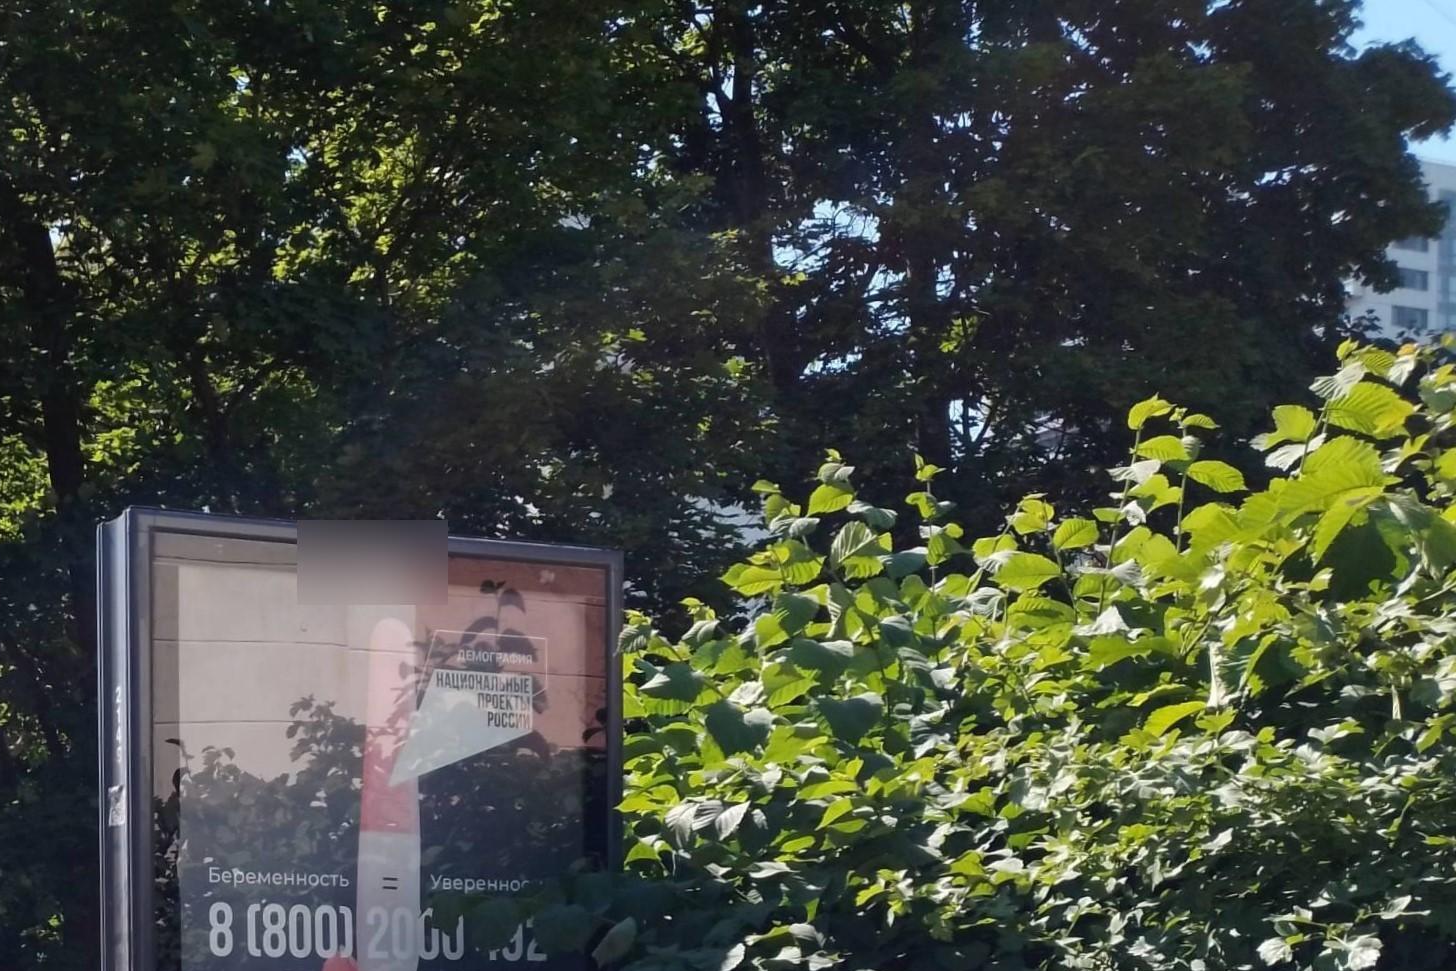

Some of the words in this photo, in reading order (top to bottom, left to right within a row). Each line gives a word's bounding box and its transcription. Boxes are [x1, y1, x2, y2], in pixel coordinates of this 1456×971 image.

[456, 649, 533, 665] ДЕМОГРАФИЯ
[436, 671, 530, 694] НАЦИОНАЛЬНЫЕ
[477, 692, 530, 711] ПРОЕКТЫ
[487, 711, 530, 729] РОССИИ
[208, 866, 350, 888] Беременность
[208, 901, 234, 957] 8
[247, 903, 353, 959] (800)
